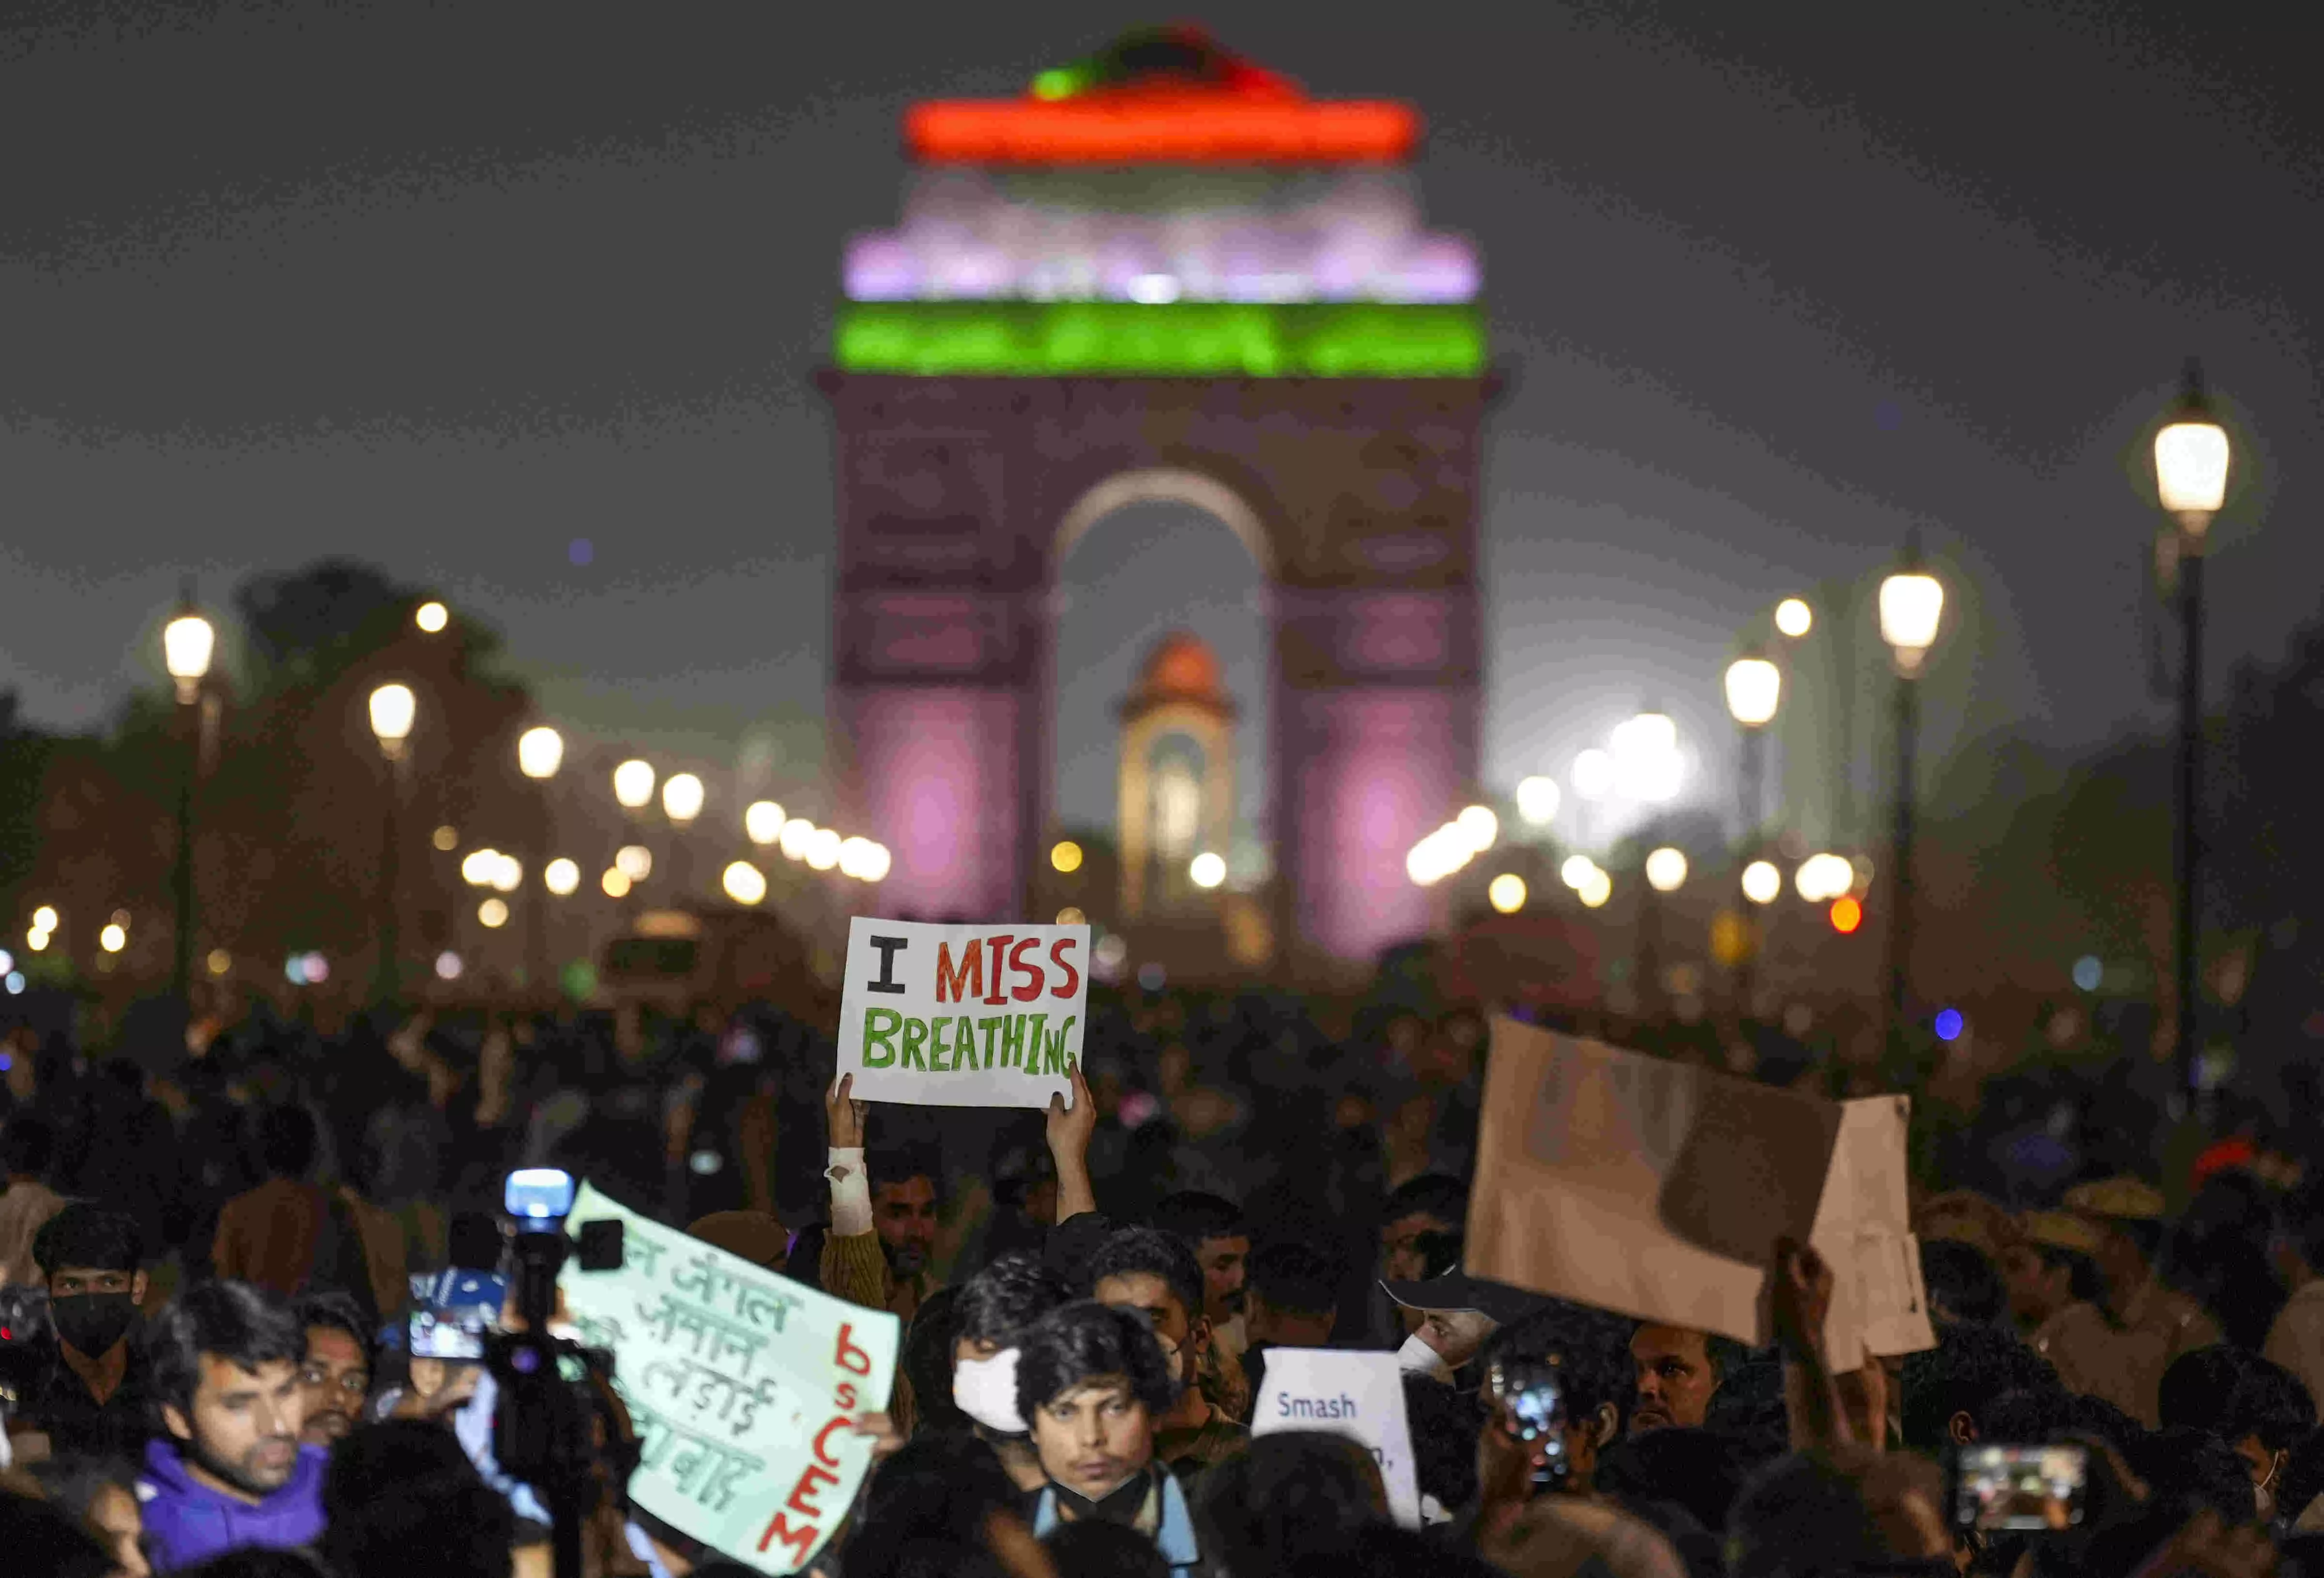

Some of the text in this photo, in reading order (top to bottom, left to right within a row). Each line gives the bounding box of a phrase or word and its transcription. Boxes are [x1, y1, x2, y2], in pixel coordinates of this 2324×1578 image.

[867, 935, 1079, 1005] I MISS
[862, 1007, 1076, 1079] BREATHING
[1277, 1391, 1356, 1419] Smash
